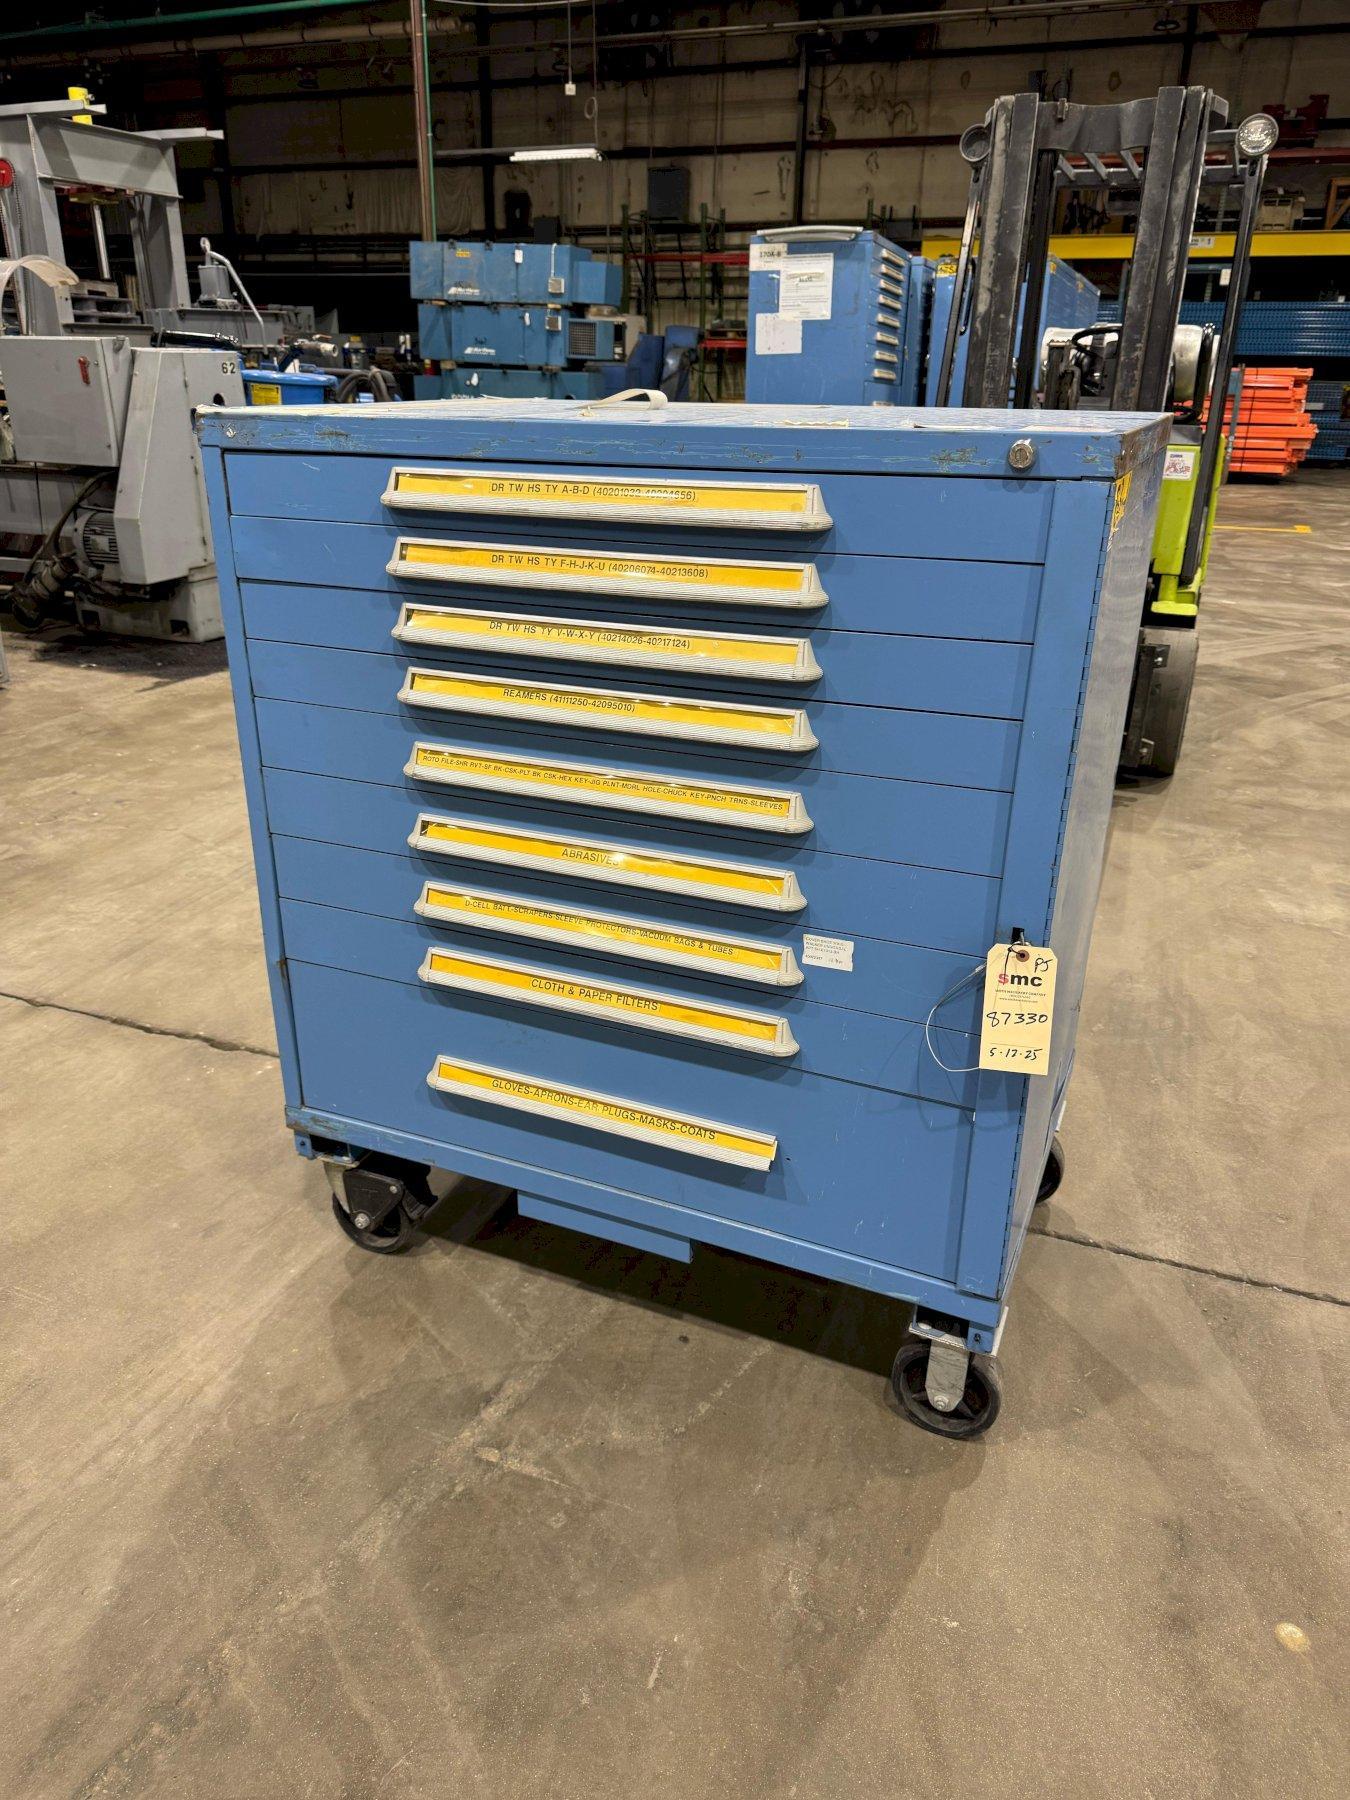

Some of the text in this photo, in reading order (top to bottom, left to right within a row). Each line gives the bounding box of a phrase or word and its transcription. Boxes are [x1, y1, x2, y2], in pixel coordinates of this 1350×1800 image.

[222, 362, 236, 374] 62
[491, 482, 505, 492] DR
[509, 483, 524, 493] TW
[527, 483, 541, 493] HS
[545, 484, 558, 494] TY
[562, 485, 590, 495] A-B-D
[491, 554, 709, 579] DR TW HS TY F-H-J-K-U (40206074-40213608)
[489, 620, 691, 650] DR TW HS TY V-W-X-Y (40214026-40217124)
[502, 688, 636, 713] REAMERS (41111250-42095010)
[422, 755, 440, 764] ROTO
[440, 757, 469, 768] FILE-SHR
[532, 769, 541, 778] BK
[543, 771, 573, 783] CSK-HEX
[574, 776, 601, 787] KEY-JIG
[642, 785, 687, 798] HOLE-CHUCK
[689, 791, 727, 803] KEY-PNCH
[729, 796, 784, 812] TRNS-SLEEVES
[465, 899, 491, 910] D-CELL
[673, 935, 697, 949] BAGS
[698, 941, 705, 950] &
[707, 943, 734, 957] TUBES
[997, 973, 1043, 987] smc
[531, 978, 659, 1011] CLOTH & PAPER FILTERS
[986, 1011, 1049, 1028] 87330
[491, 1078, 717, 1141] GLOVES-APRONS-EAR PLUGS-MASKS-COATS
